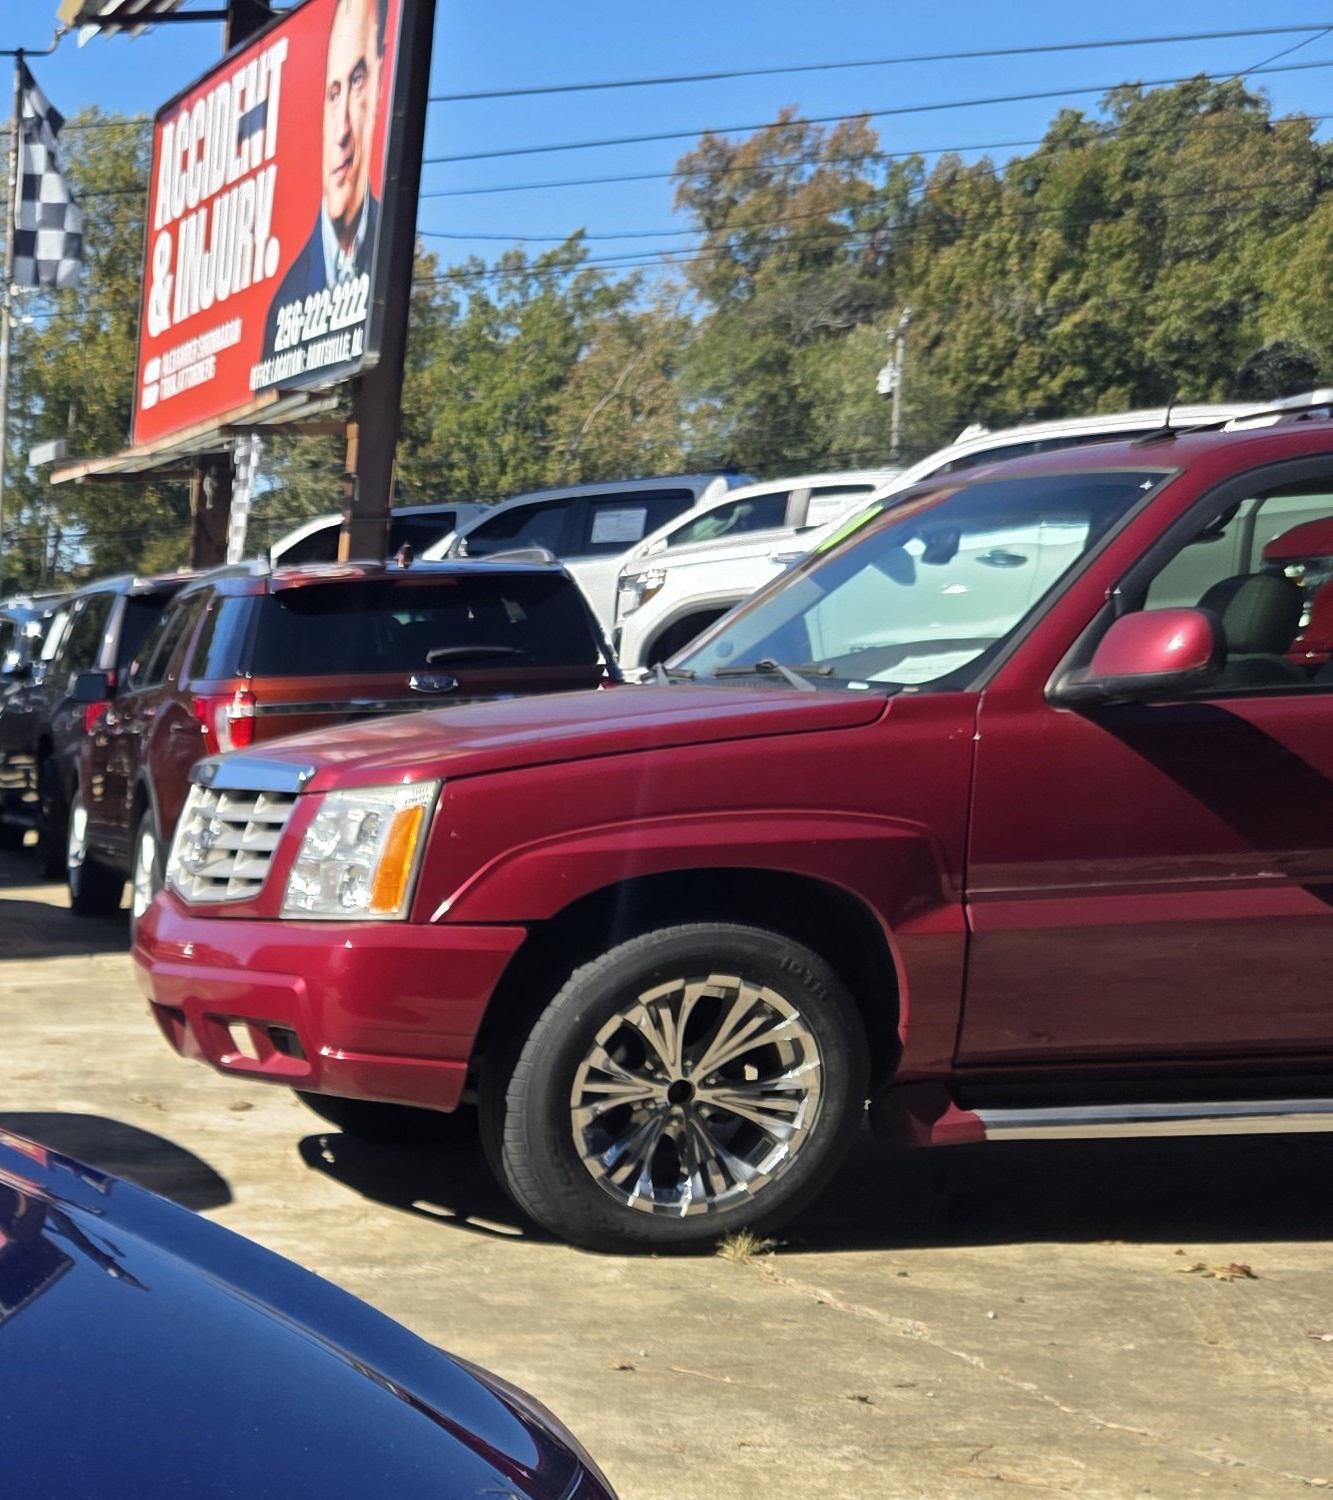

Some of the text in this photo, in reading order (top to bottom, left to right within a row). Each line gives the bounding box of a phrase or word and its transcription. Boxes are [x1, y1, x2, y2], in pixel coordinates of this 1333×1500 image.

[154, 37, 289, 231] ACCIDENT
[148, 164, 280, 337] & INJURY.
[275, 273, 369, 352] 256-222-2222
